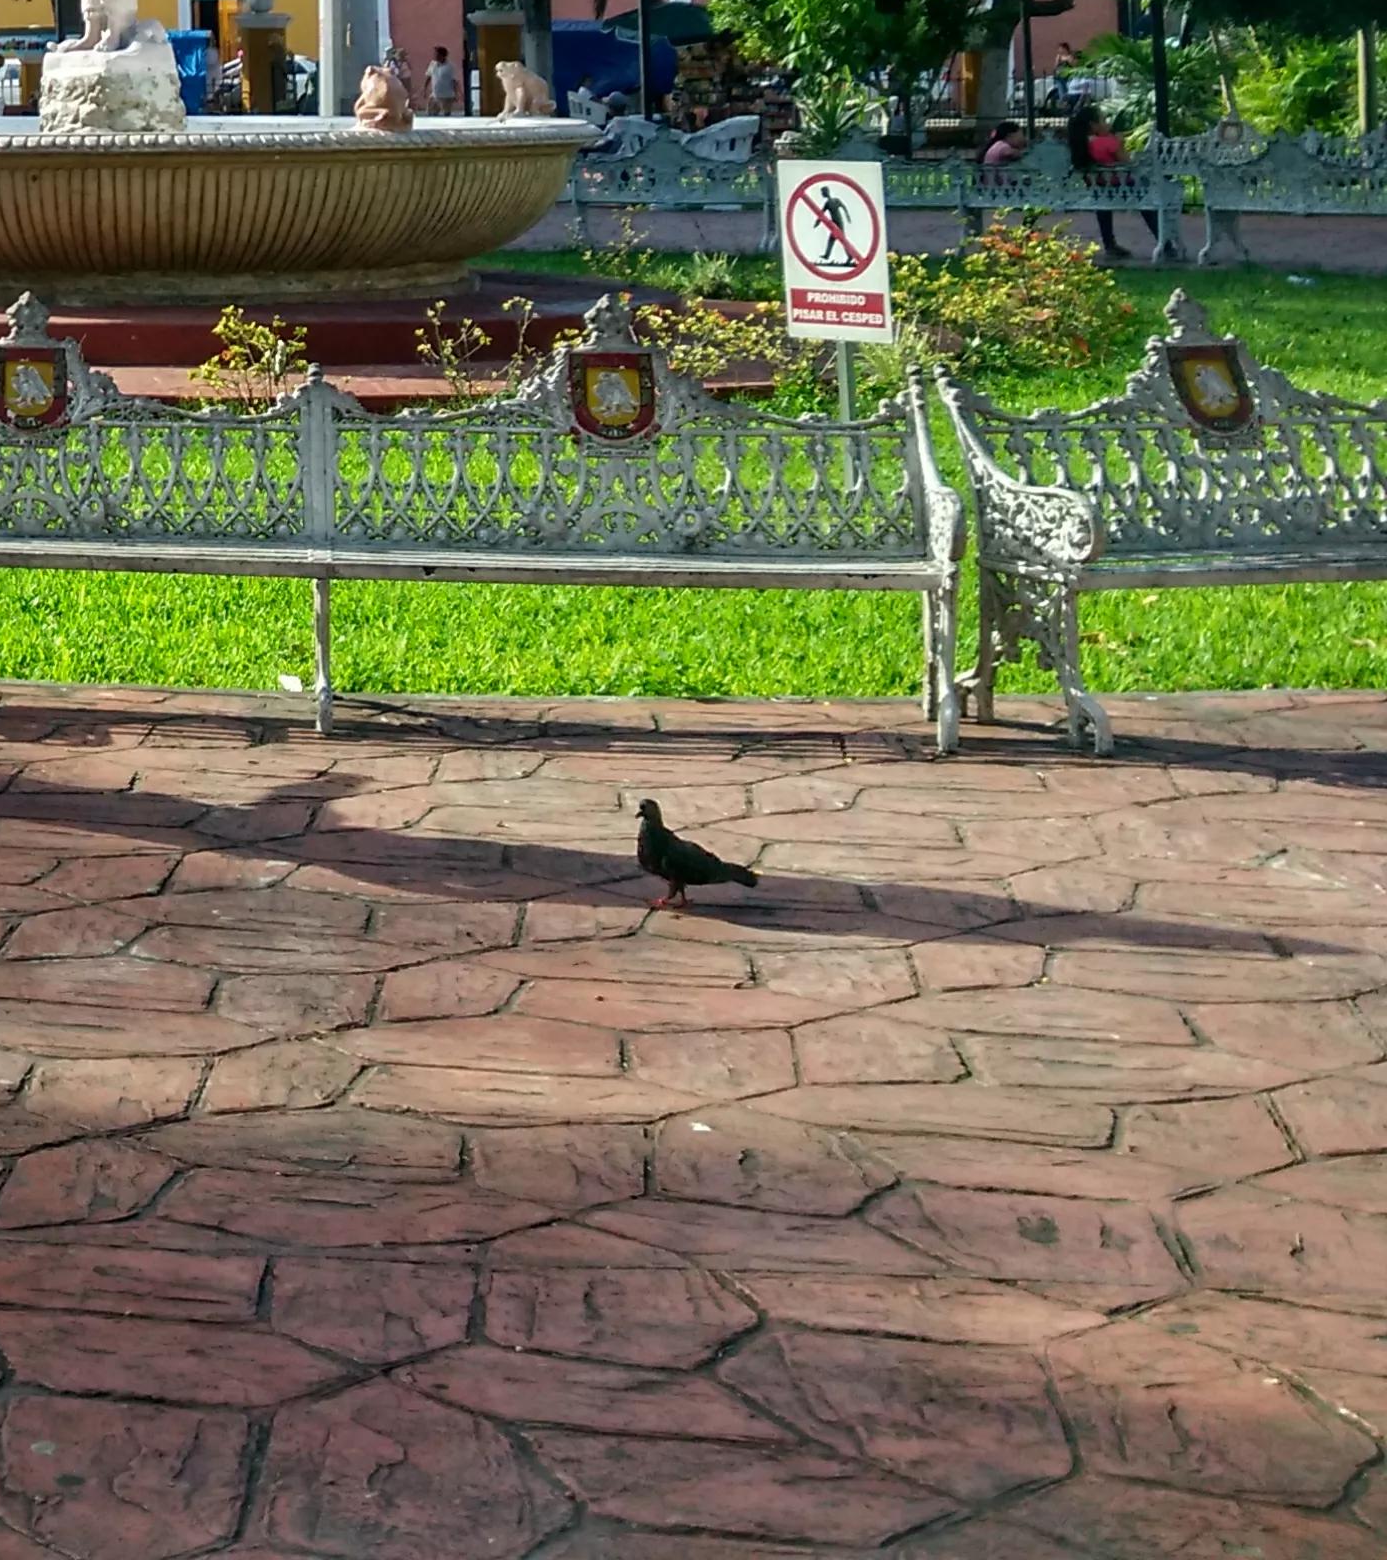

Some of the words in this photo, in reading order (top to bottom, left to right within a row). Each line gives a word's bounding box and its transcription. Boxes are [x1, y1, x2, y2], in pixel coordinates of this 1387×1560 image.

[807, 292, 866, 306] PROHIBIDO
[793, 308, 824, 320] PISAR
[826, 310, 840, 322] EL
[841, 312, 884, 325] CESPED
